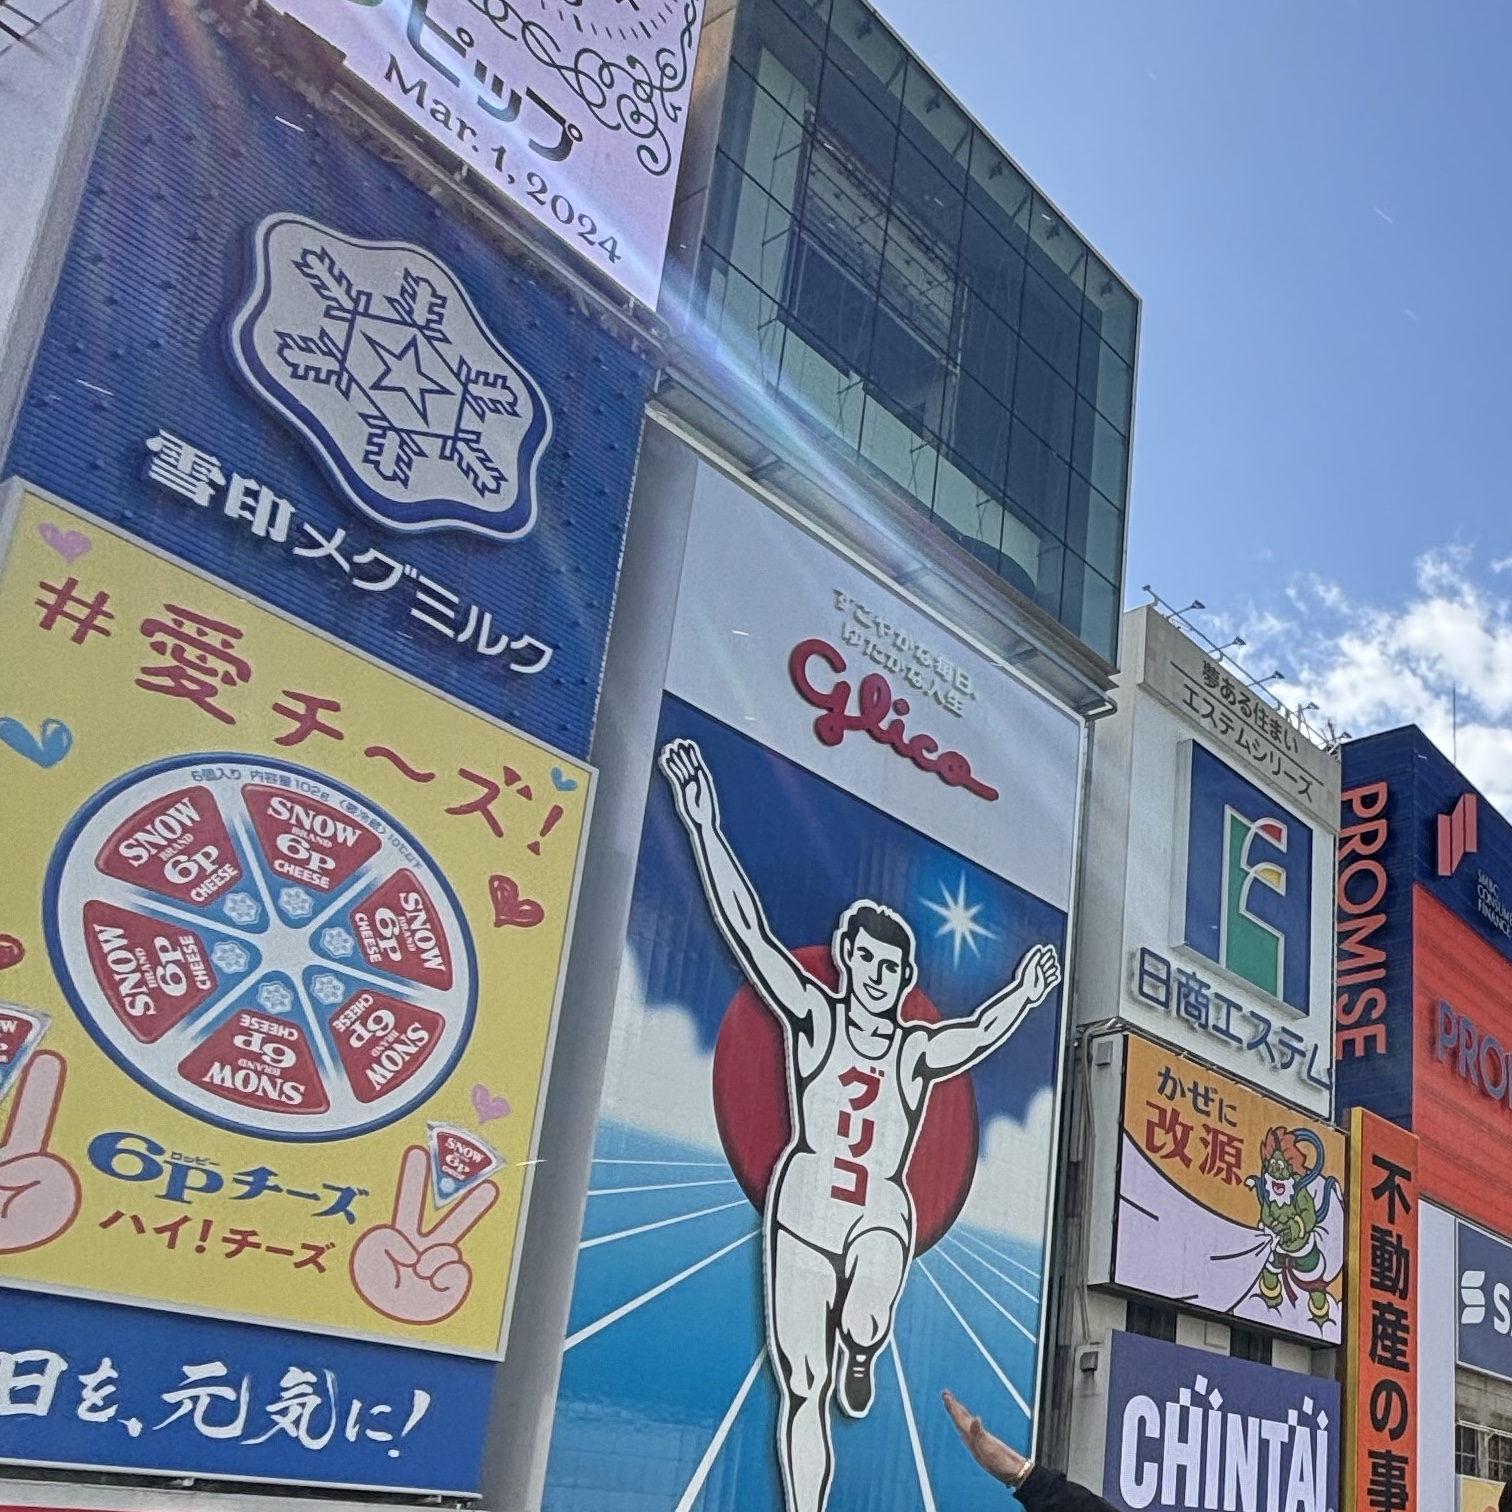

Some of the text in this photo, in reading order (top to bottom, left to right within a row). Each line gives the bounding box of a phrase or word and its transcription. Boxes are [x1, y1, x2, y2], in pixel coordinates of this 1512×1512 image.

[384, 52, 622, 264] Mar. 1, 2024
[144, 429, 554, 675] 雪印メグミルク
[841, 621, 964, 720] ゆたかな人生
[788, 637, 1001, 803] Glico
[1202, 660, 1299, 754] 夢ある住まい
[1181, 683, 1314, 804] エステムシリーズ
[119, 797, 201, 868] SNOW
[266, 796, 363, 848] SNOW
[276, 833, 336, 874] 6P
[163, 844, 220, 885] 6P
[190, 863, 239, 903] CHEESE
[273, 859, 330, 890] CHEESE
[354, 911, 383, 964] CHEESE
[374, 907, 403, 963] 6P
[399, 892, 447, 973] SNOW
[1335, 781, 1389, 1062] PROMISE
[93, 923, 157, 1018] SNOW
[153, 935, 188, 998] 6P
[178, 934, 212, 991] CHEESE
[239, 1013, 299, 1042] CHEESE
[332, 993, 375, 1034] CHEESE
[349, 1009, 396, 1049] 6P
[1138, 946, 1334, 1092] 日商エステム
[233, 1030, 298, 1069] 6P
[365, 1021, 430, 1092] SNOW
[202, 1061, 306, 1106] SNOW
[1157, 1065, 1238, 1128] かぜに
[829, 1064, 886, 1208] グリコ
[1144, 1099, 1245, 1187] 改源
